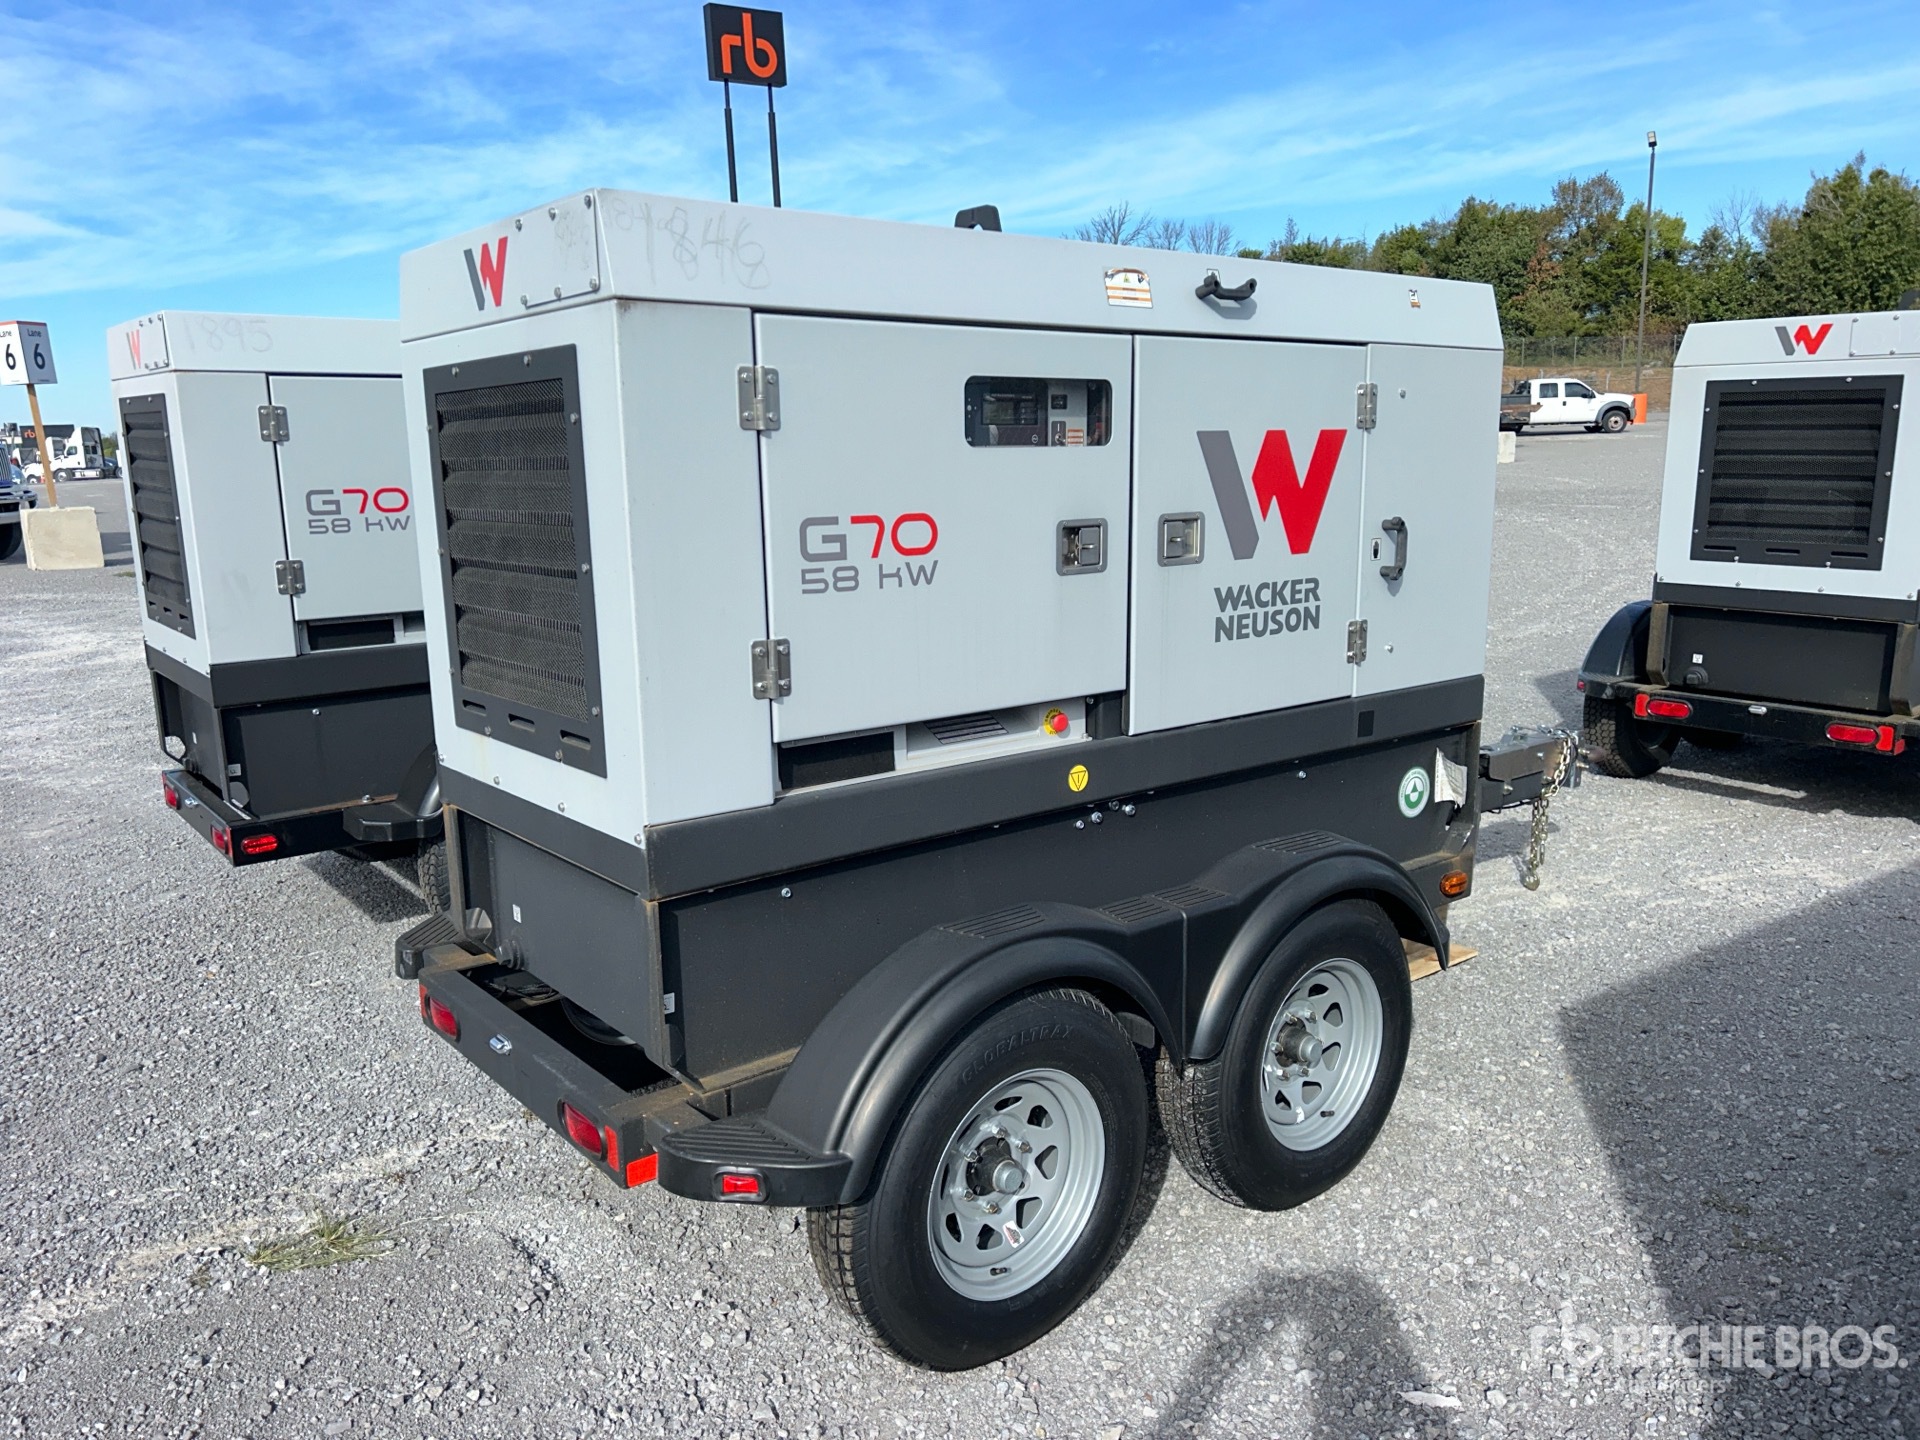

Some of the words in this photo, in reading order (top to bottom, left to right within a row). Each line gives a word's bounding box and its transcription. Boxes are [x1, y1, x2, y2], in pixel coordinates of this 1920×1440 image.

[720, 12, 778, 78] rb
[26, 328, 43, 338] Lane
[183, 317, 274, 353] 1895
[5, 343, 17, 370] 6
[33, 343, 46, 370] 6
[305, 487, 410, 516] G70
[308, 517, 351, 535] 58
[799, 512, 939, 563] G70
[801, 565, 860, 595] 58
[1213, 577, 1321, 613] WACKER
[1214, 604, 1321, 643] NEUSON
